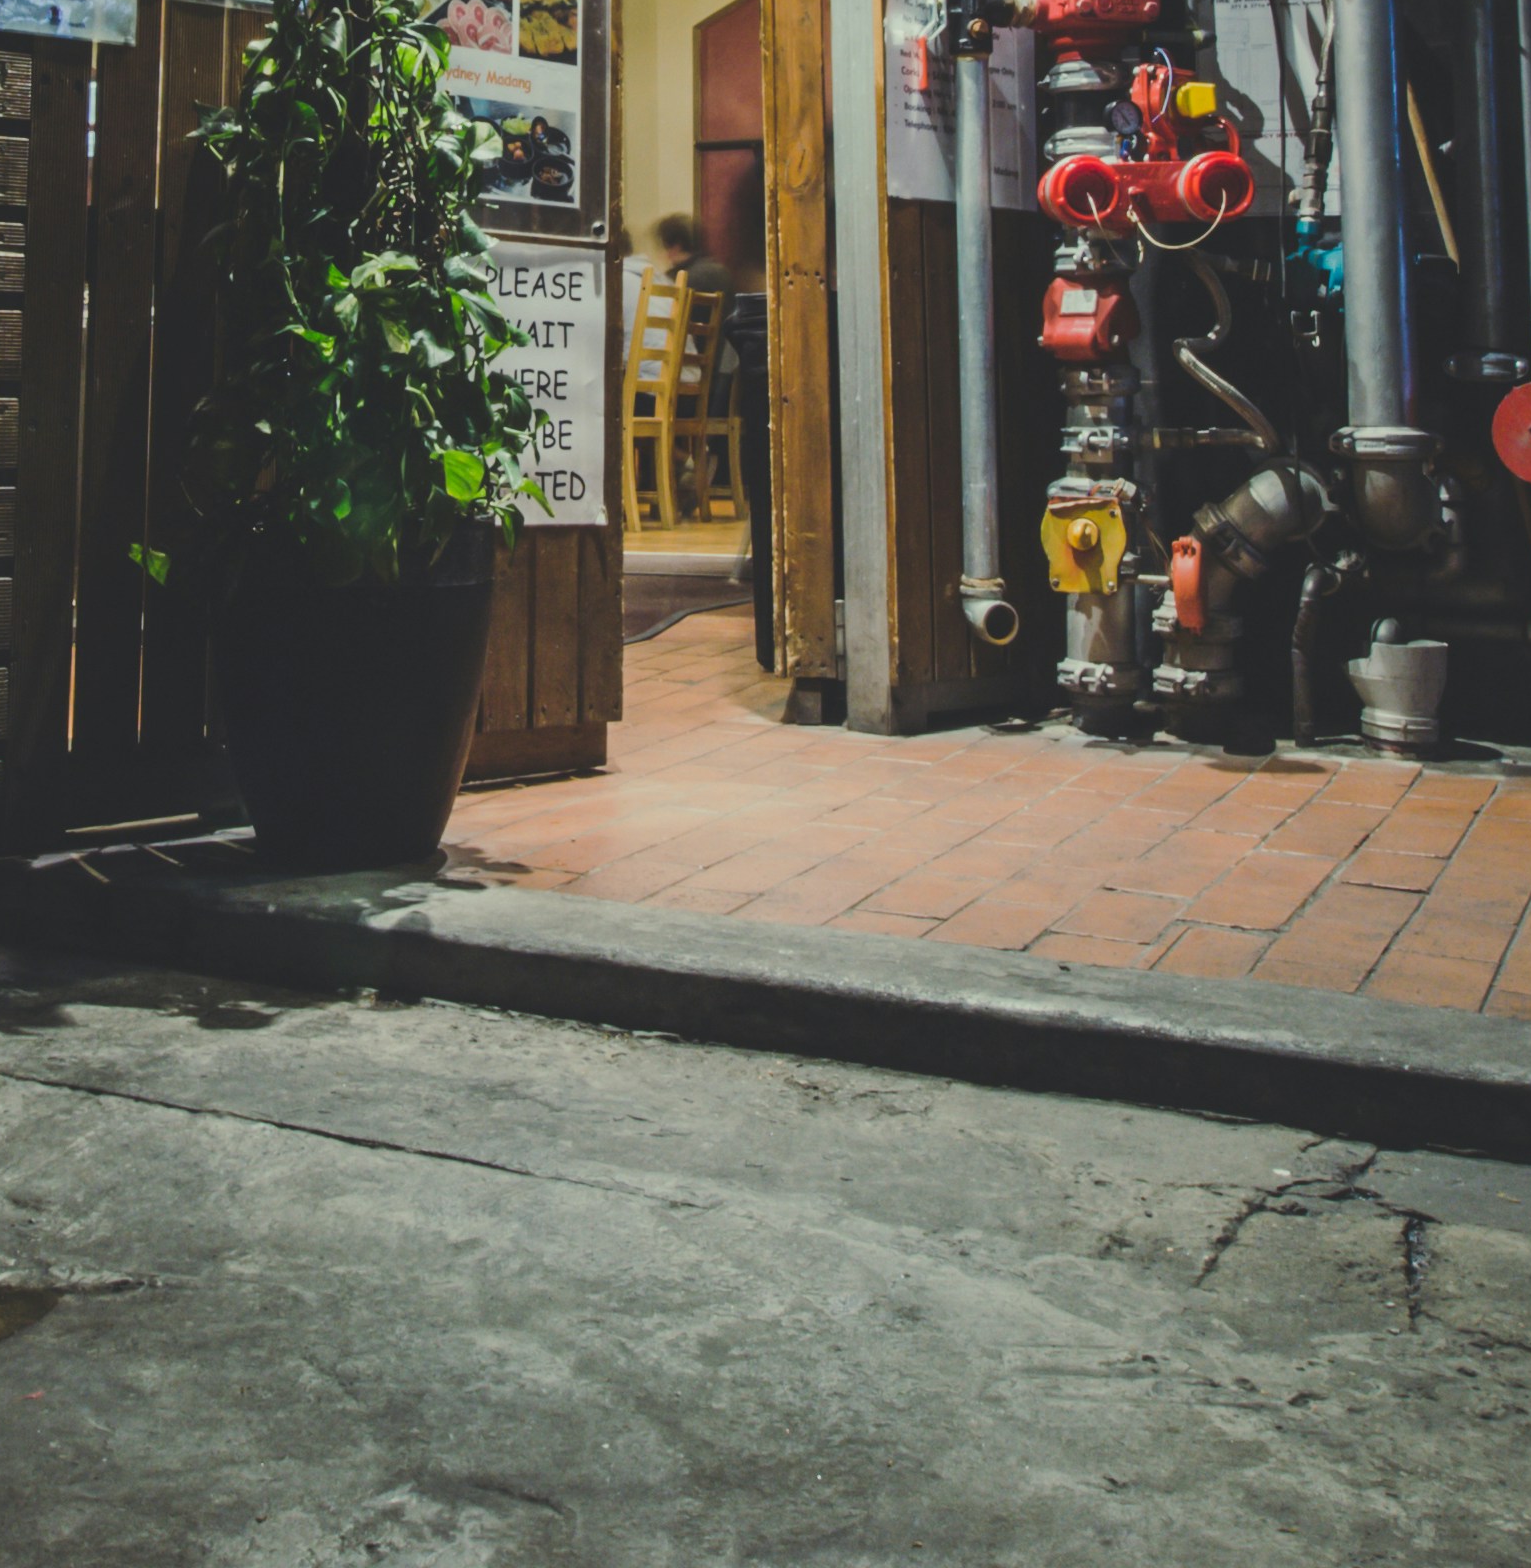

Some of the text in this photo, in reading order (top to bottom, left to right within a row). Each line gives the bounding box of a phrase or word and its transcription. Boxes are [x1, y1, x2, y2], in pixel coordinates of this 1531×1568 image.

[442, 65, 532, 93] ydney Madang
[500, 368, 569, 400] ERE
[542, 419, 573, 450] BE
